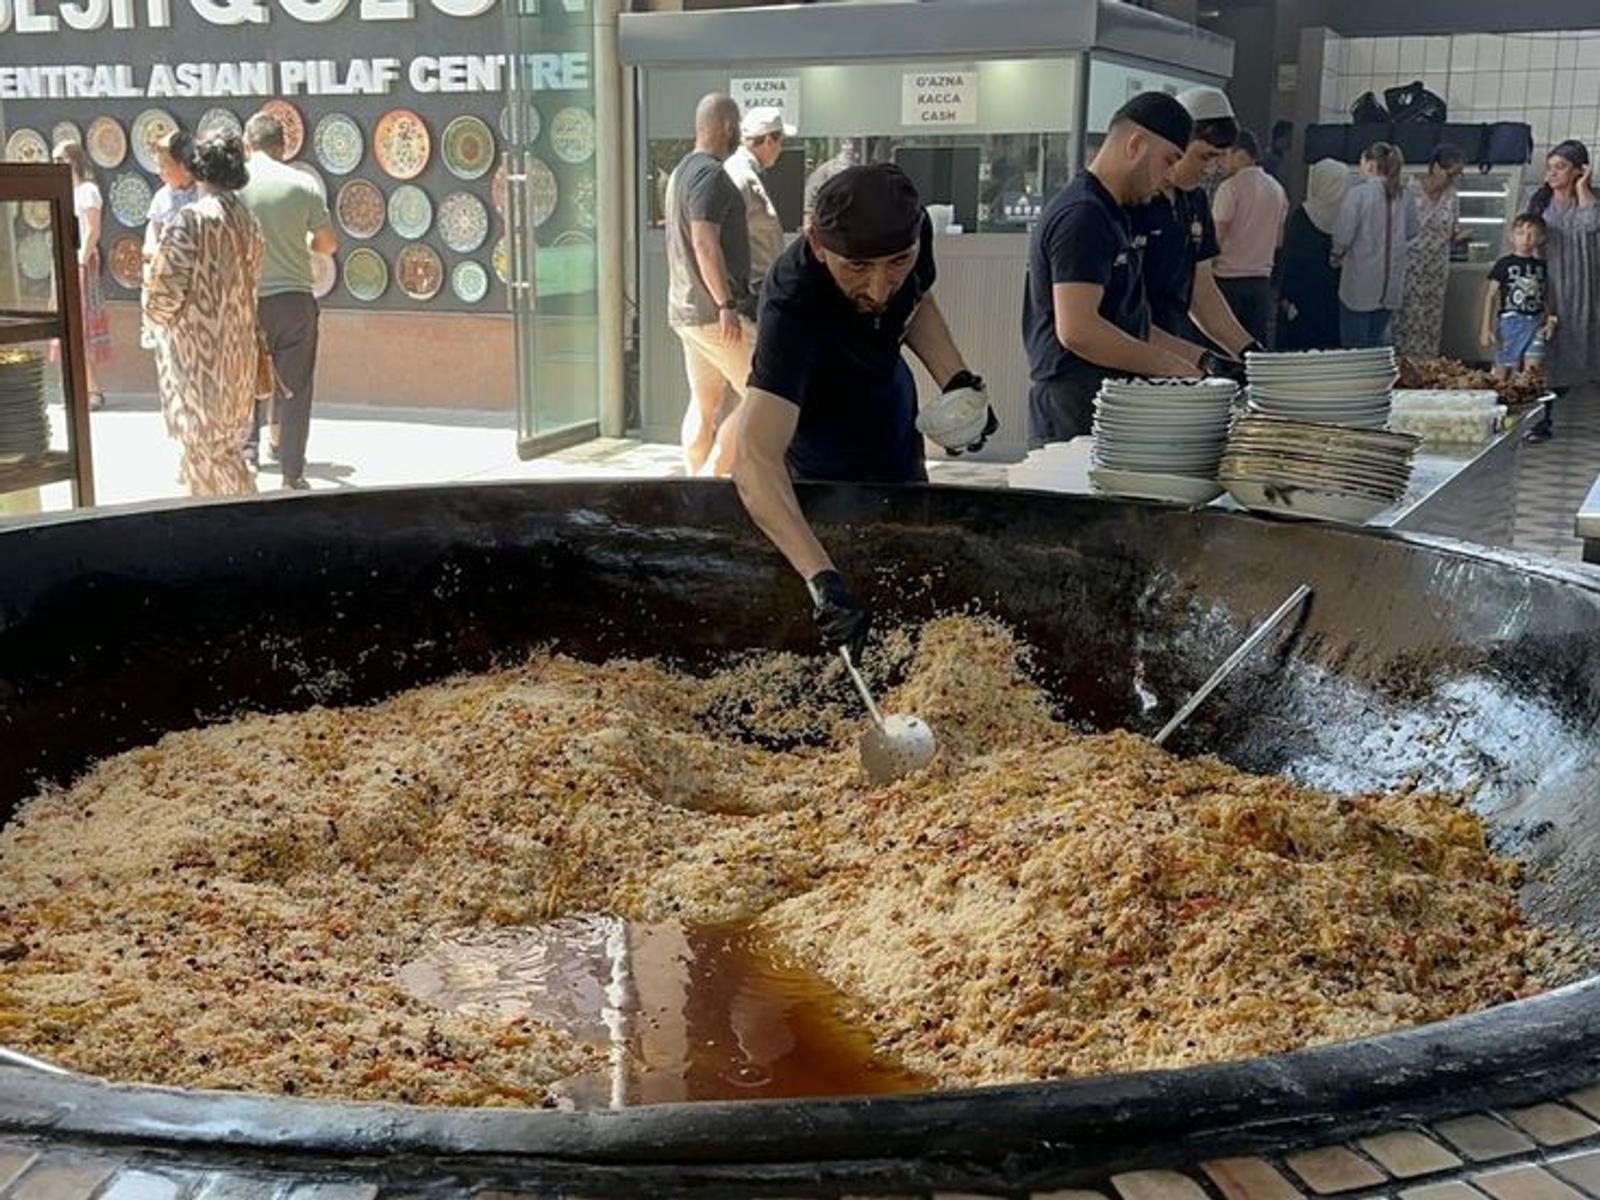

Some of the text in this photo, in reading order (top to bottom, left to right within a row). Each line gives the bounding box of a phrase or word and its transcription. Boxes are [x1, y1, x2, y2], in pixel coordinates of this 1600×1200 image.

[147, 61, 272, 97] ASIAN
[280, 58, 400, 95] PILAF
[408, 53, 588, 93] CENTRE
[921, 111, 956, 122] CASH
